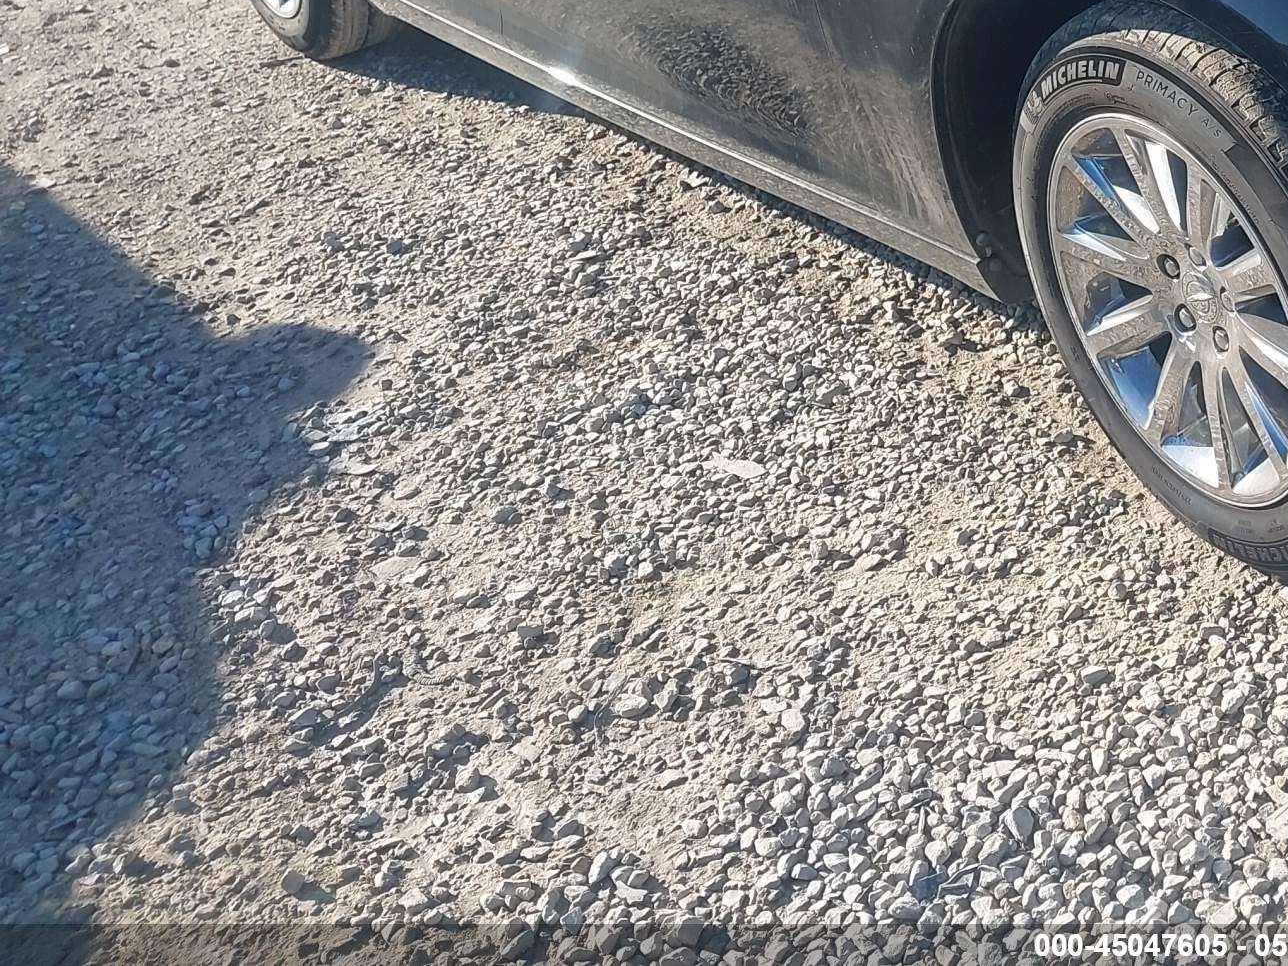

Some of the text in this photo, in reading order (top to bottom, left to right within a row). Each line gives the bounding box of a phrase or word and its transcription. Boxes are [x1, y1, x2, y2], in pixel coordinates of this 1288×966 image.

[1041, 59, 1120, 100] MICHELIN
[1135, 69, 1199, 116] PRIMACY
[1201, 117, 1222, 138] A/S
